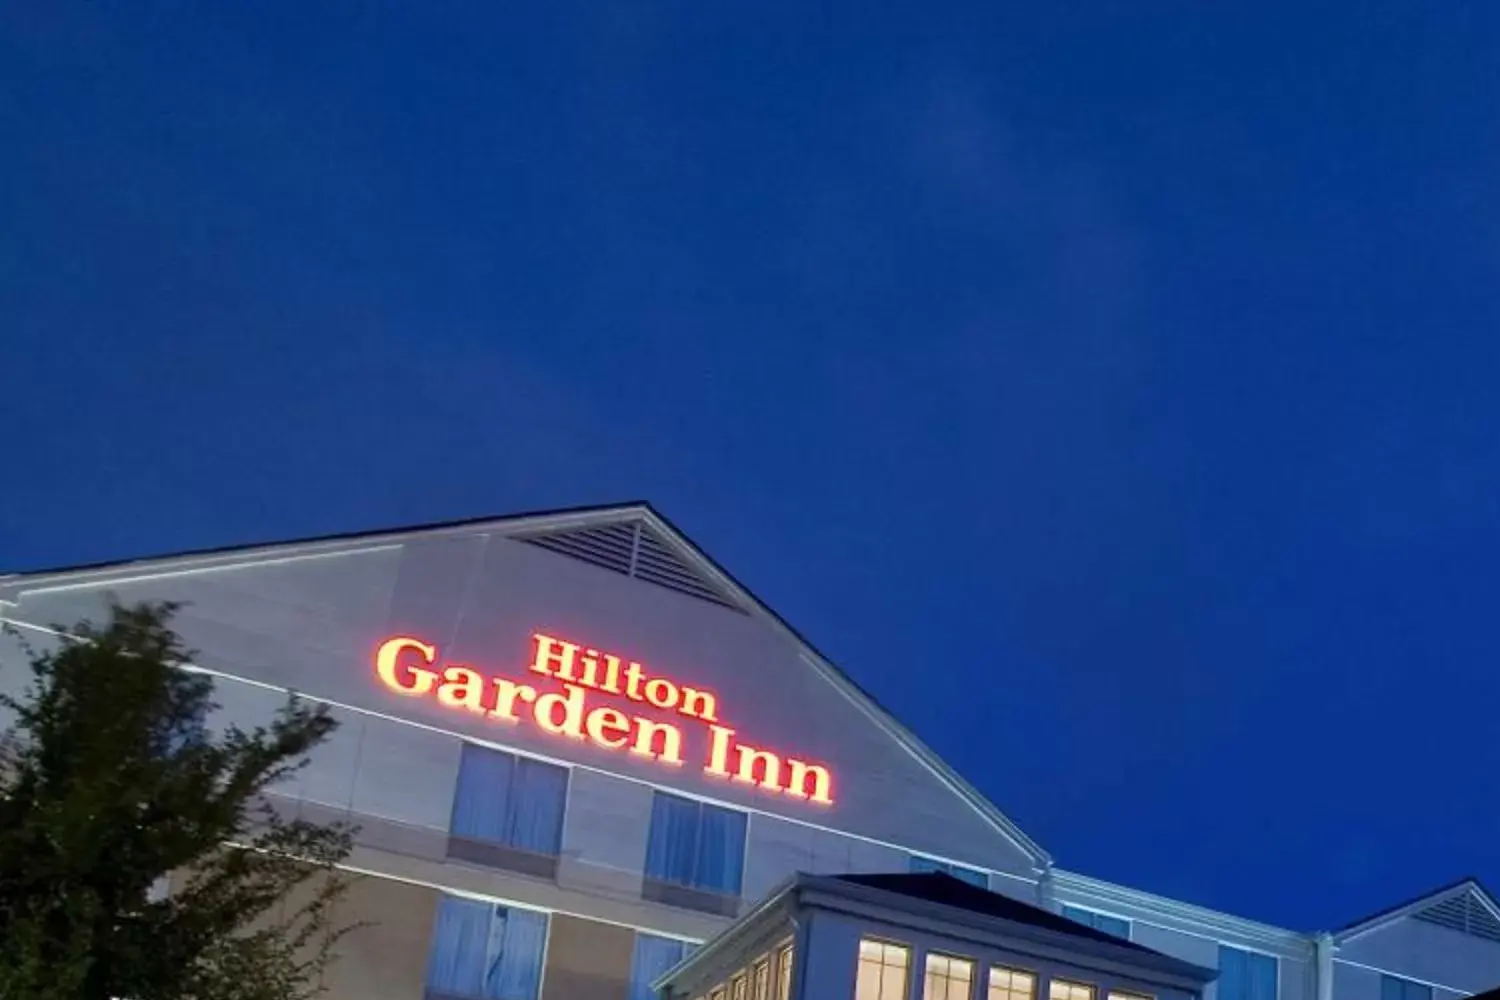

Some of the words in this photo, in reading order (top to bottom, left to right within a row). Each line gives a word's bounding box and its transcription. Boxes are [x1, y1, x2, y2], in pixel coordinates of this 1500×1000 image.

[375, 637, 686, 766] Garden
[703, 724, 834, 805] Inn
[530, 634, 719, 722] Hilton
